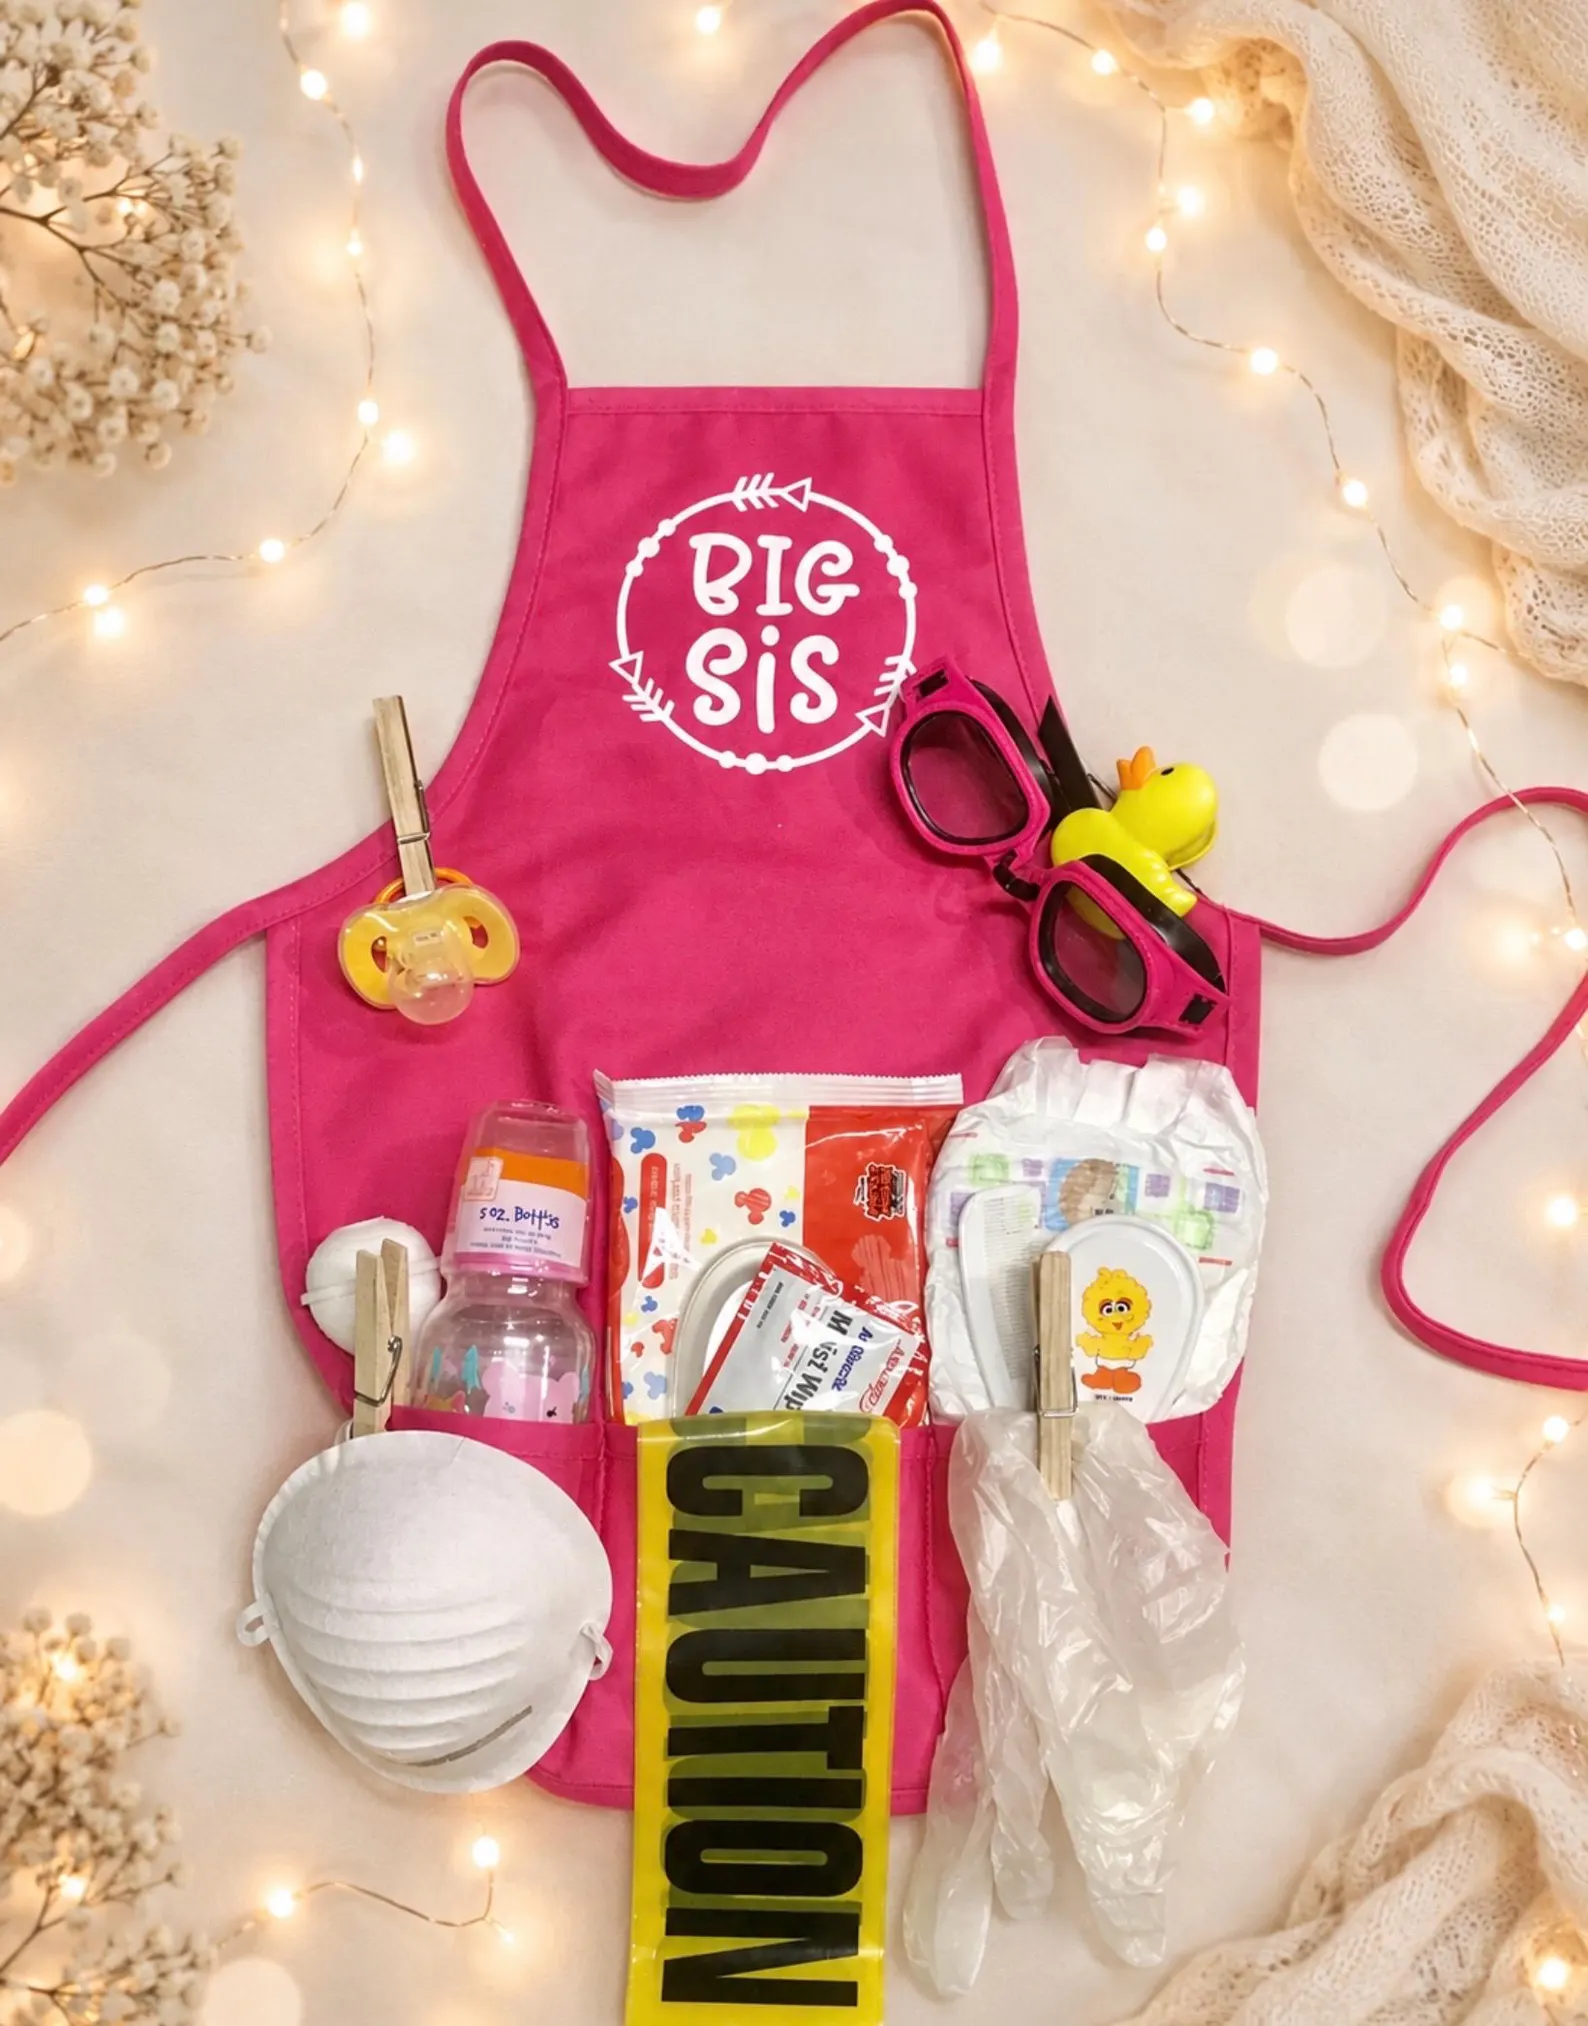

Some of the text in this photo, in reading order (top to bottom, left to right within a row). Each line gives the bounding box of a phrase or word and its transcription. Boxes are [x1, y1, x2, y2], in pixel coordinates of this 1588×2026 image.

[688, 532, 860, 616] BIG
[807, 1310, 853, 1373] Mist
[661, 1444, 870, 2007] CAUTION
